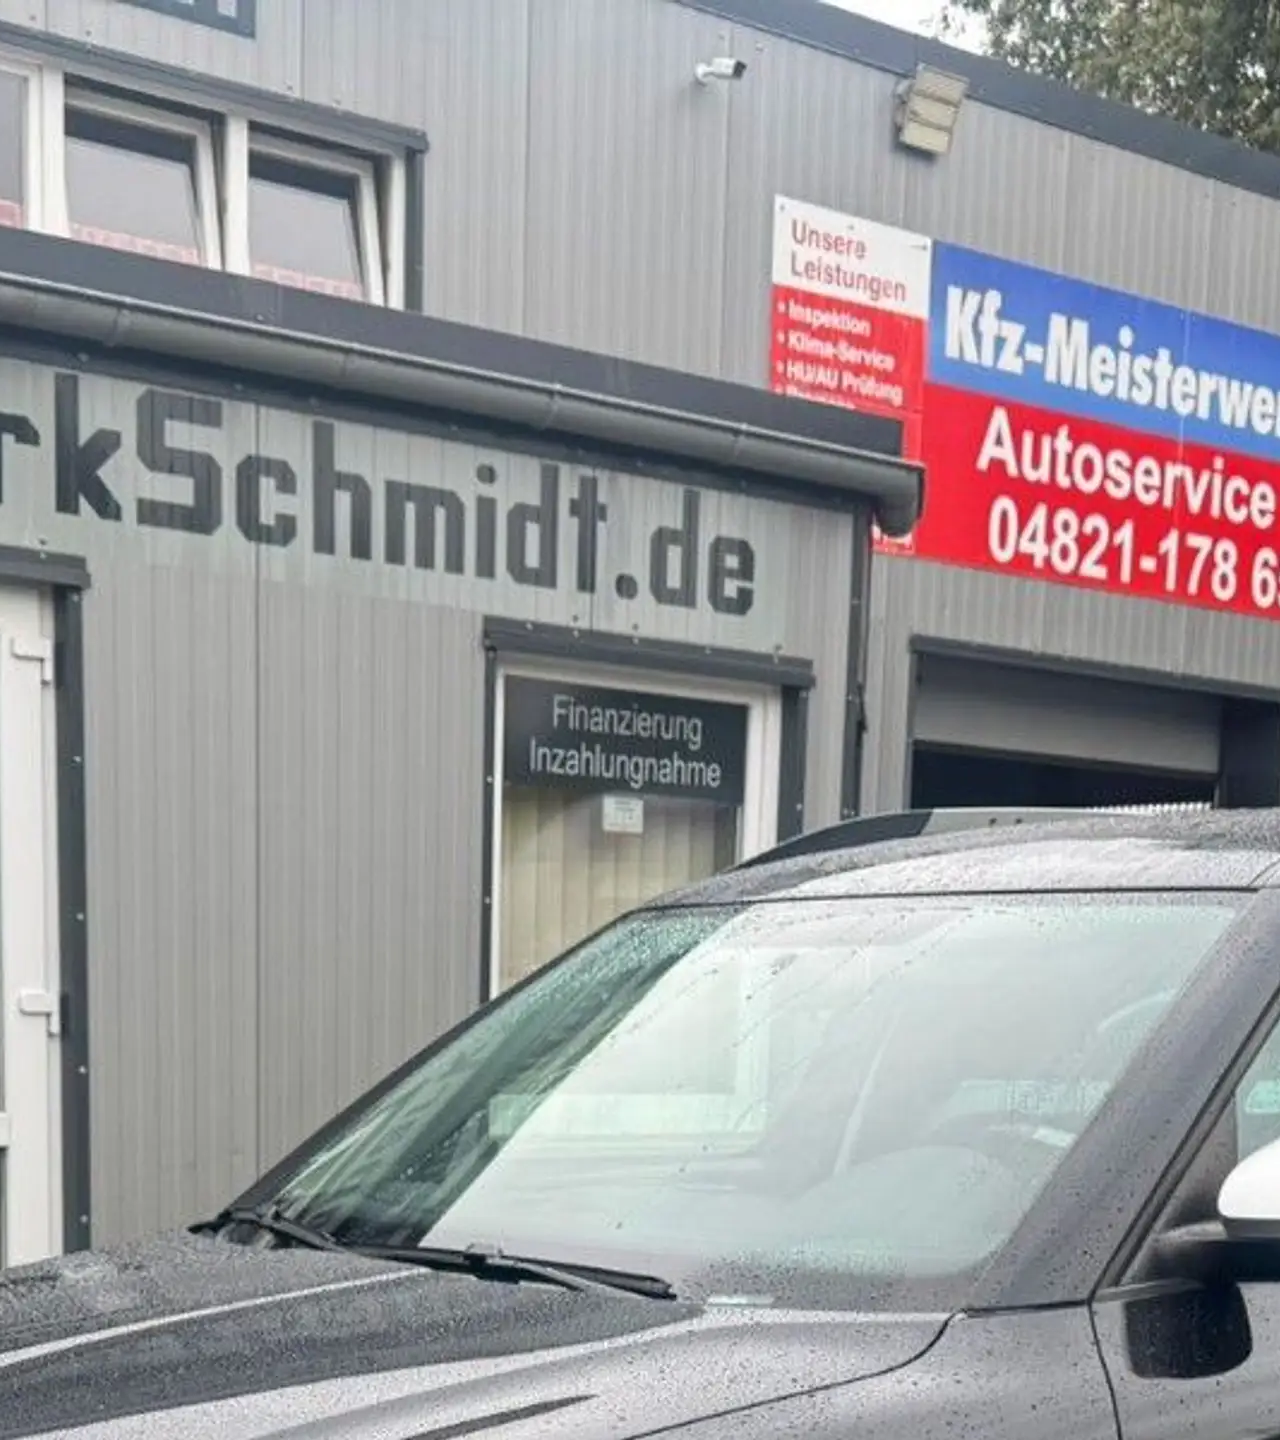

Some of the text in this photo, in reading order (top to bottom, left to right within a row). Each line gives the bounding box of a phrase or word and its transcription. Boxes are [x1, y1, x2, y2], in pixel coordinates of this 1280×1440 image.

[791, 219, 867, 259] Unsere
[791, 250, 907, 301] Leistungen
[976, 406, 1276, 529] Autoservice
[988, 495, 1237, 602] 04821-178
[552, 694, 703, 750] Finanzierung
[530, 736, 721, 789] Inzahlungnahme
